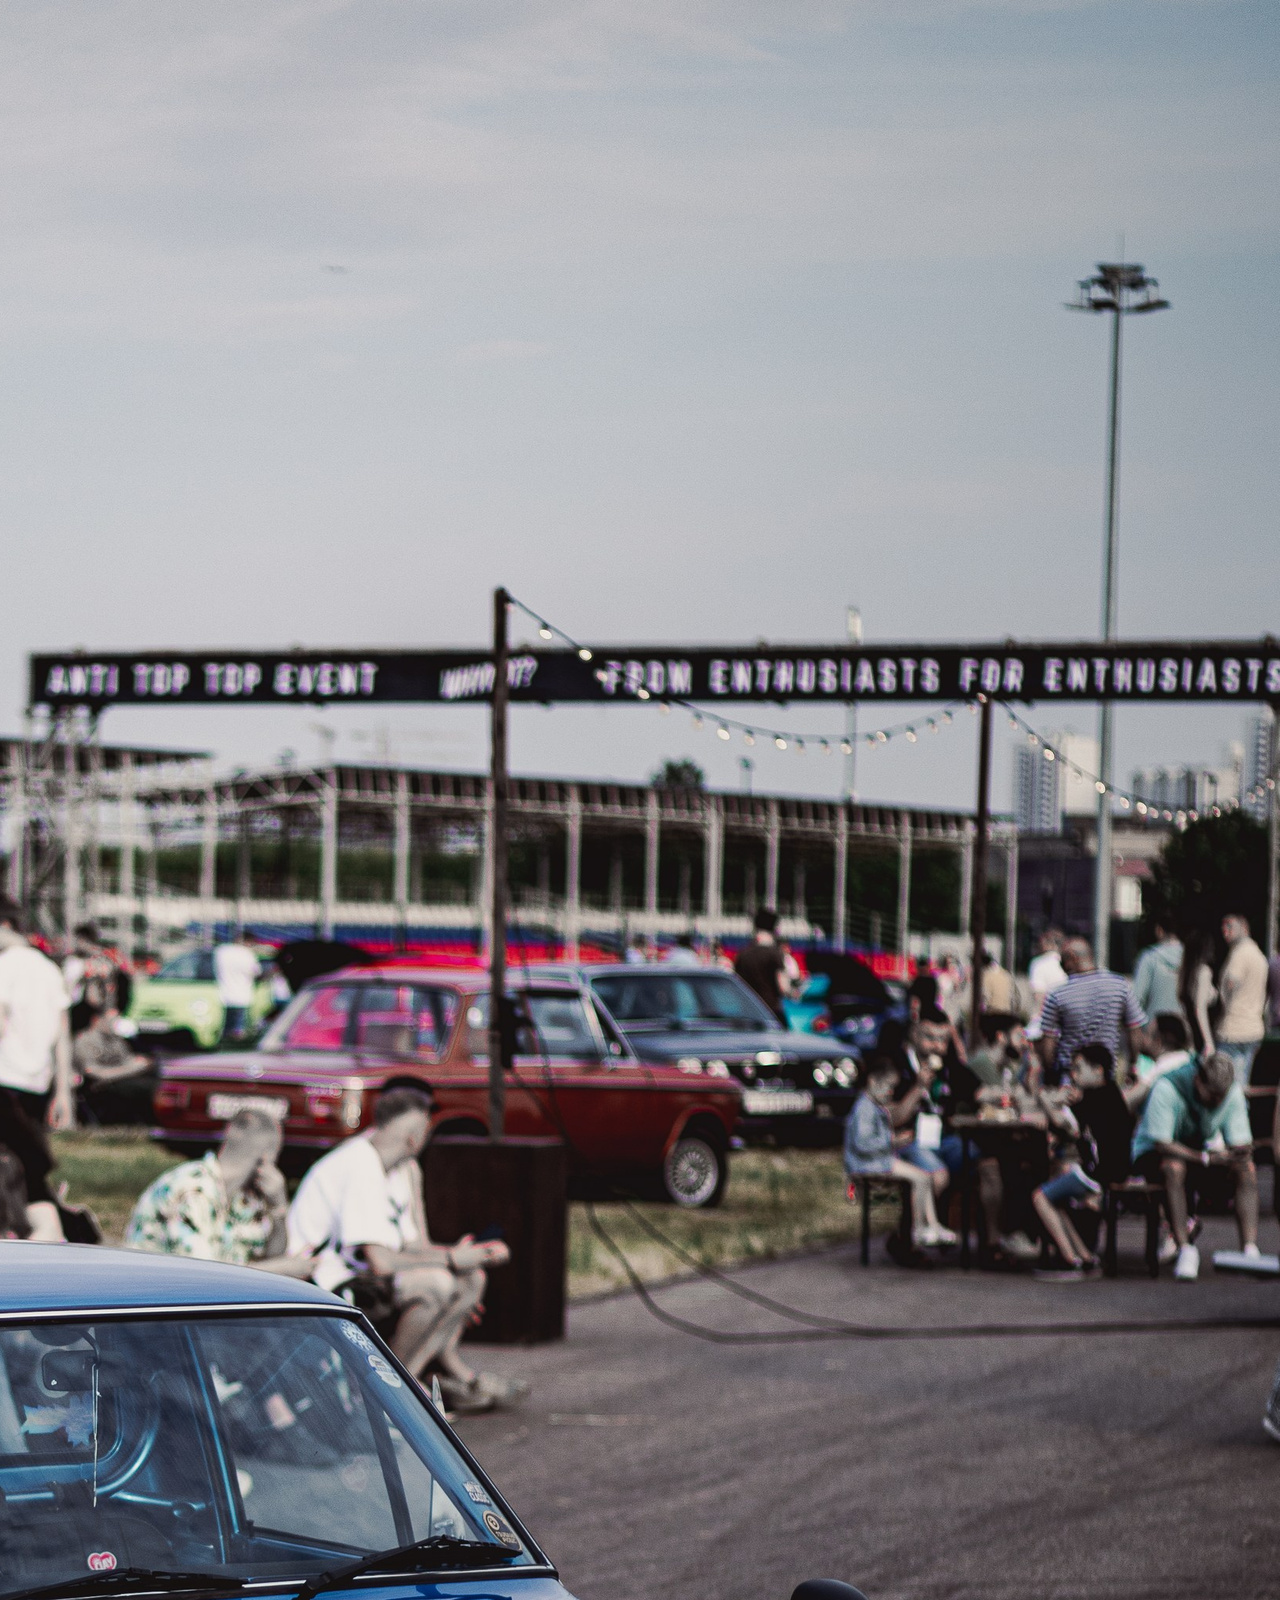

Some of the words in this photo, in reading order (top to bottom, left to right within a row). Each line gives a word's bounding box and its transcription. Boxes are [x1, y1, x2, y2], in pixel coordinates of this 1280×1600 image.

[45, 663, 118, 696] ANTI
[131, 662, 190, 696] TOP
[202, 662, 262, 696] TOP
[274, 661, 378, 696] EVENT
[600, 659, 693, 696] FROM
[708, 657, 940, 694] ENTHUSIASTS
[958, 656, 1025, 693] FOR
[1042, 656, 1280, 694] ENTHUSIASTS
